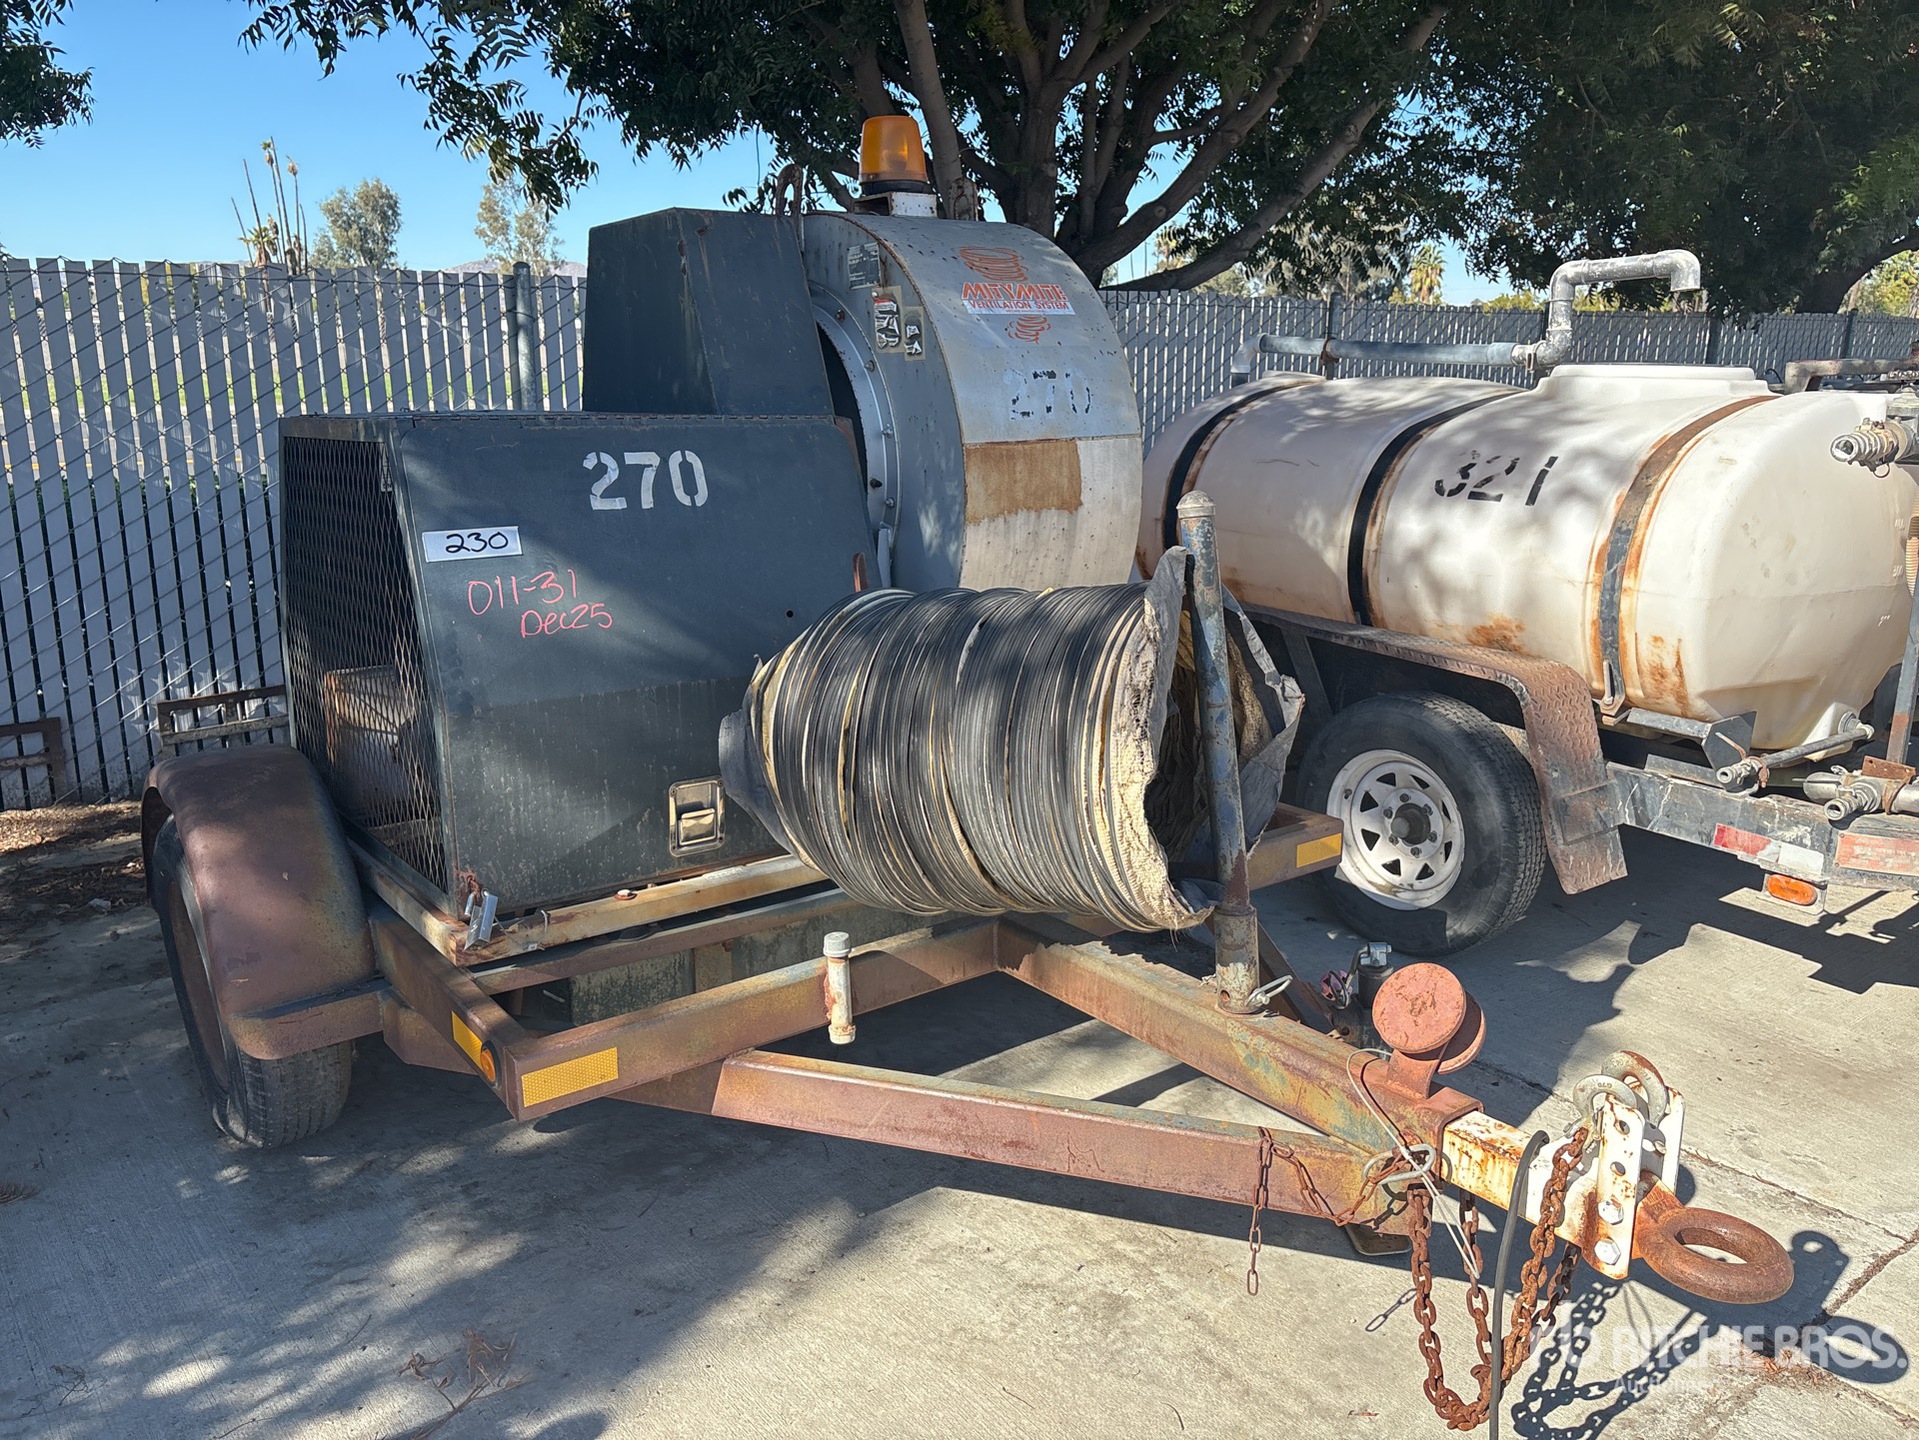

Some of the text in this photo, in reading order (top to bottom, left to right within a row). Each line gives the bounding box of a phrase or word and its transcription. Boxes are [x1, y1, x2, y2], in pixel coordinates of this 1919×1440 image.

[968, 300, 1070, 310] VENTILATION SYSTEM
[582, 450, 709, 511] 270
[1434, 450, 1558, 506] 321
[445, 532, 509, 554] 230
[468, 569, 577, 615] 011-31
